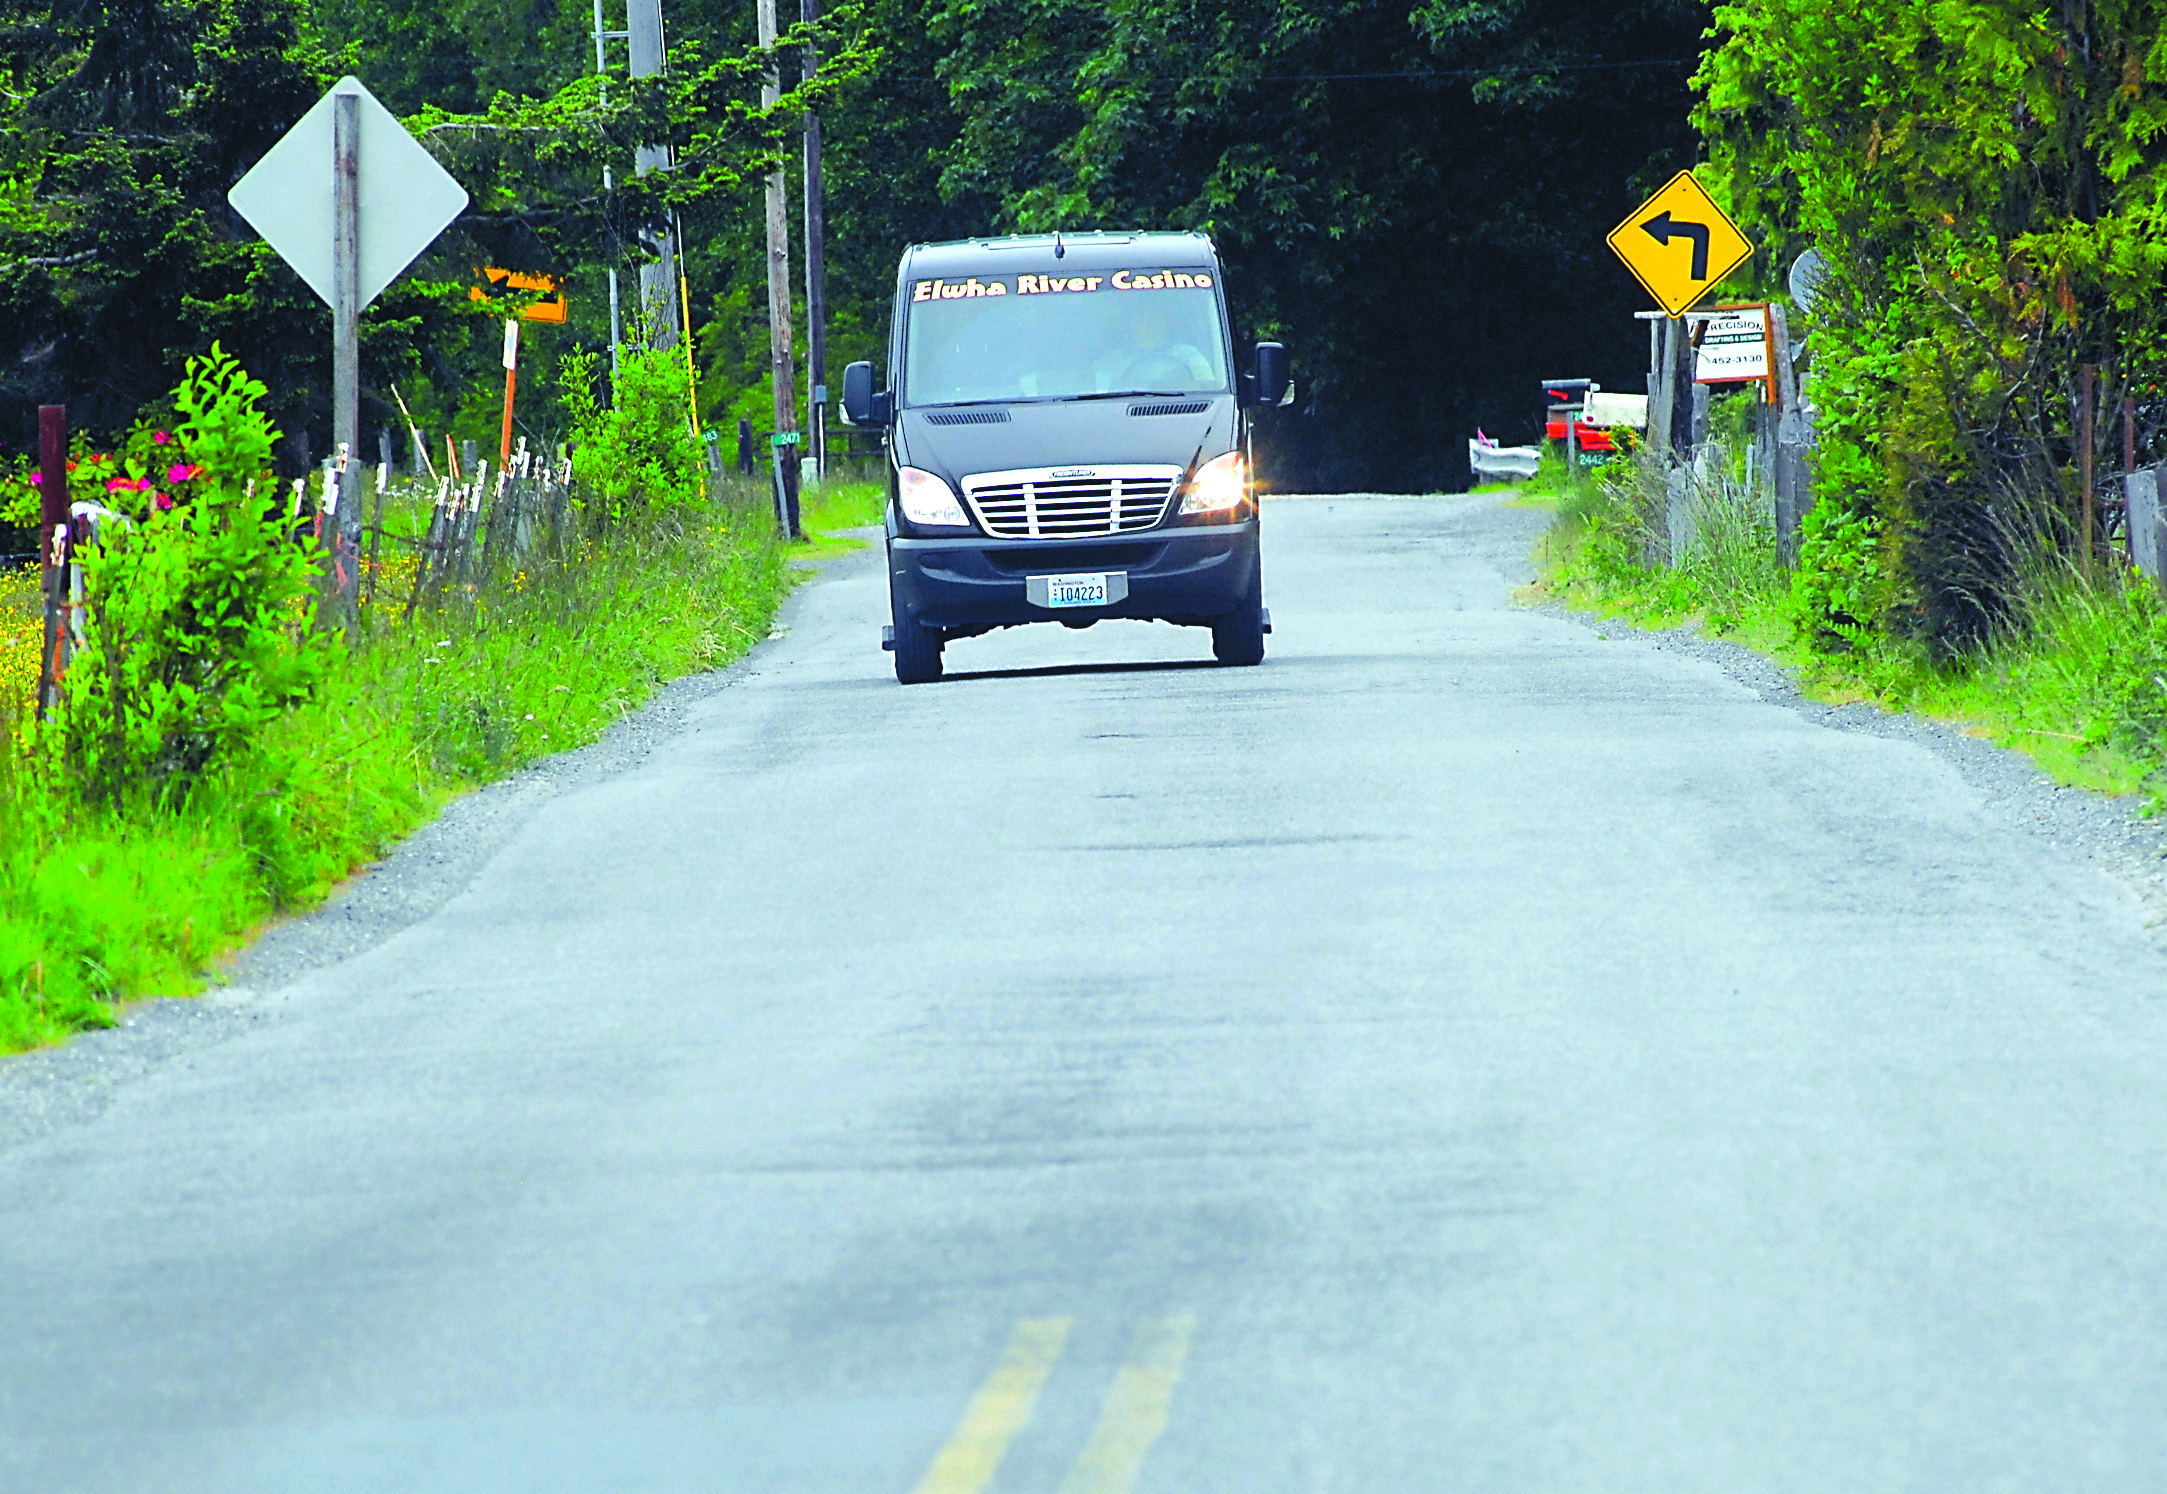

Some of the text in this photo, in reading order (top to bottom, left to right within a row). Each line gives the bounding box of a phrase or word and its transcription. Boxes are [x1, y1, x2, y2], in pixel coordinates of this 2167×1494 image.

[913, 269, 1213, 302] Elwha River Casino
[1704, 320, 1764, 332] RECISION
[1705, 335, 1733, 343] DRAFTING
[1740, 333, 1763, 342] DESIGN
[1711, 355, 1762, 364] 452-3130
[781, 433, 800, 444] 2471
[1579, 454, 1604, 465] 2442
